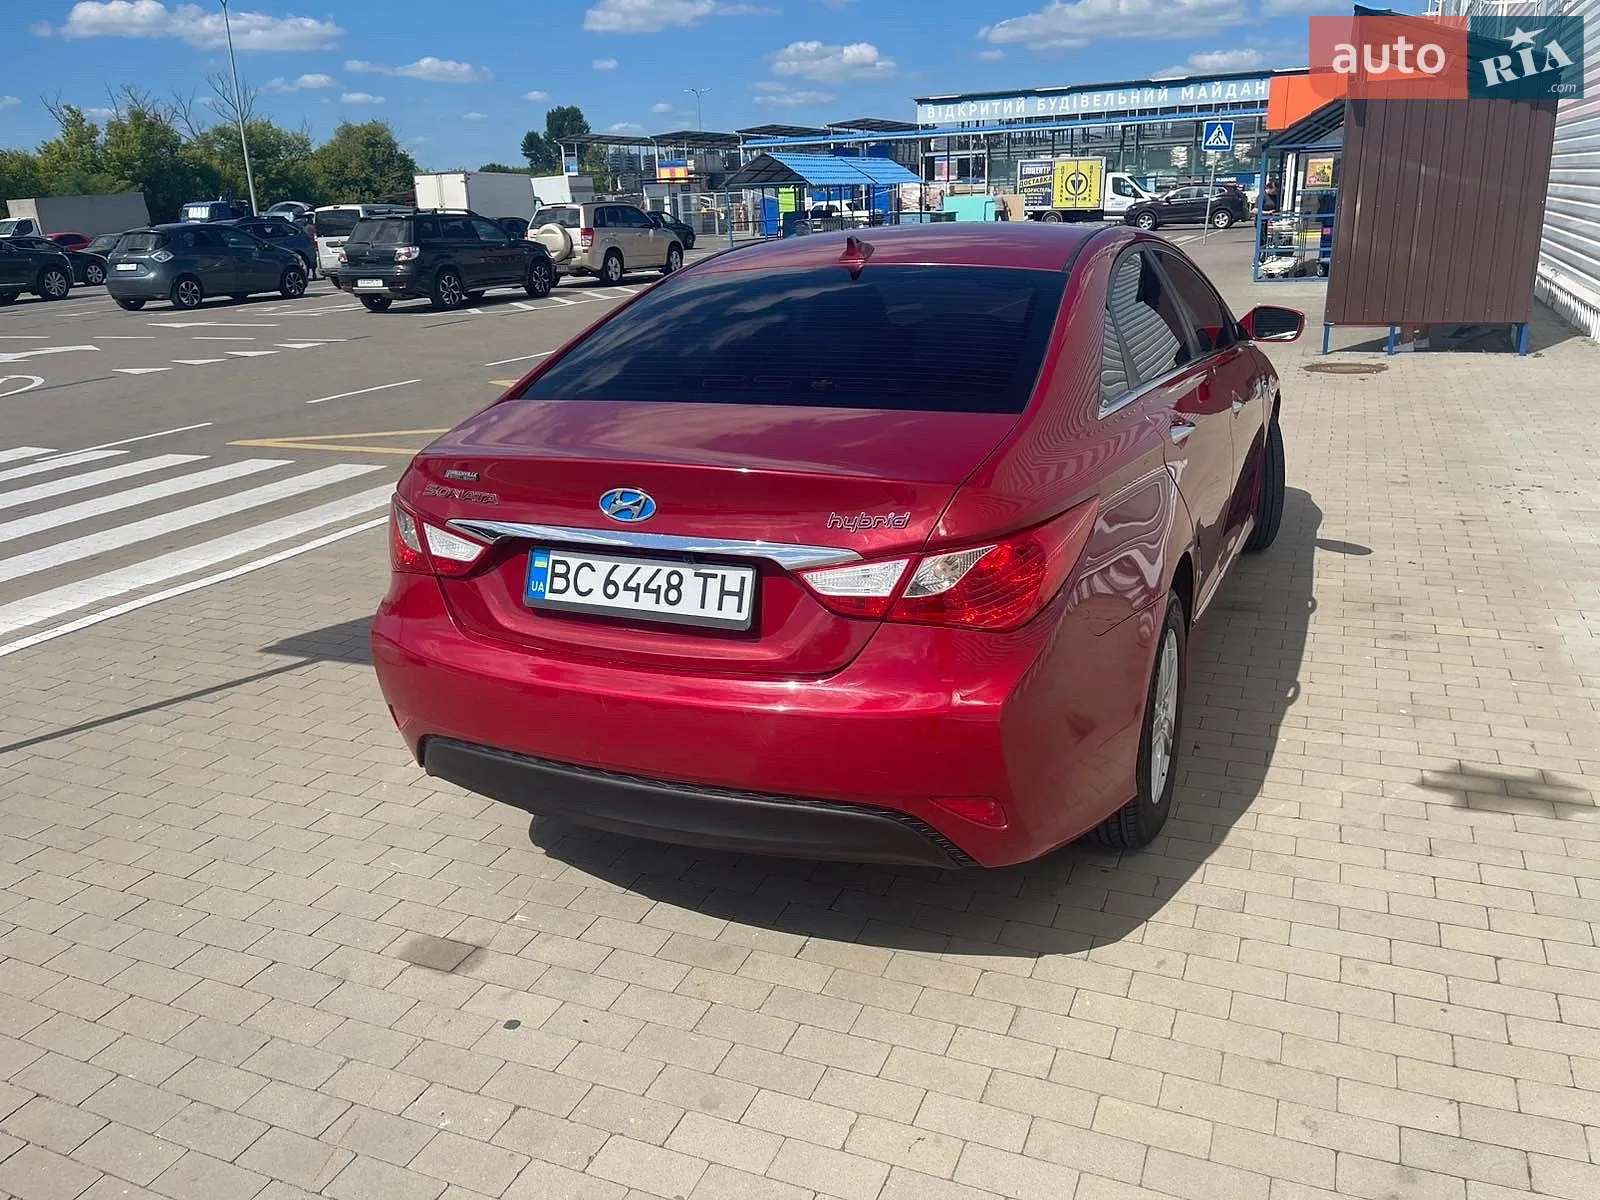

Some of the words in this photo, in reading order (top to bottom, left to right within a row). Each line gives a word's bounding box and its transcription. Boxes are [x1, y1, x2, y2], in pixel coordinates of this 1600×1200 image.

[927, 97, 1026, 119] ВІДКРИТИЙ
[1037, 86, 1169, 112] БУДІВЕЛЬНИЙ
[1181, 80, 1266, 101] МАЙДАН
[422, 483, 499, 505] SONATA
[826, 511, 911, 534] hybrid
[531, 580, 544, 593] UA
[549, 559, 597, 597] BC
[602, 564, 685, 607] 6448
[693, 570, 746, 613] TH
